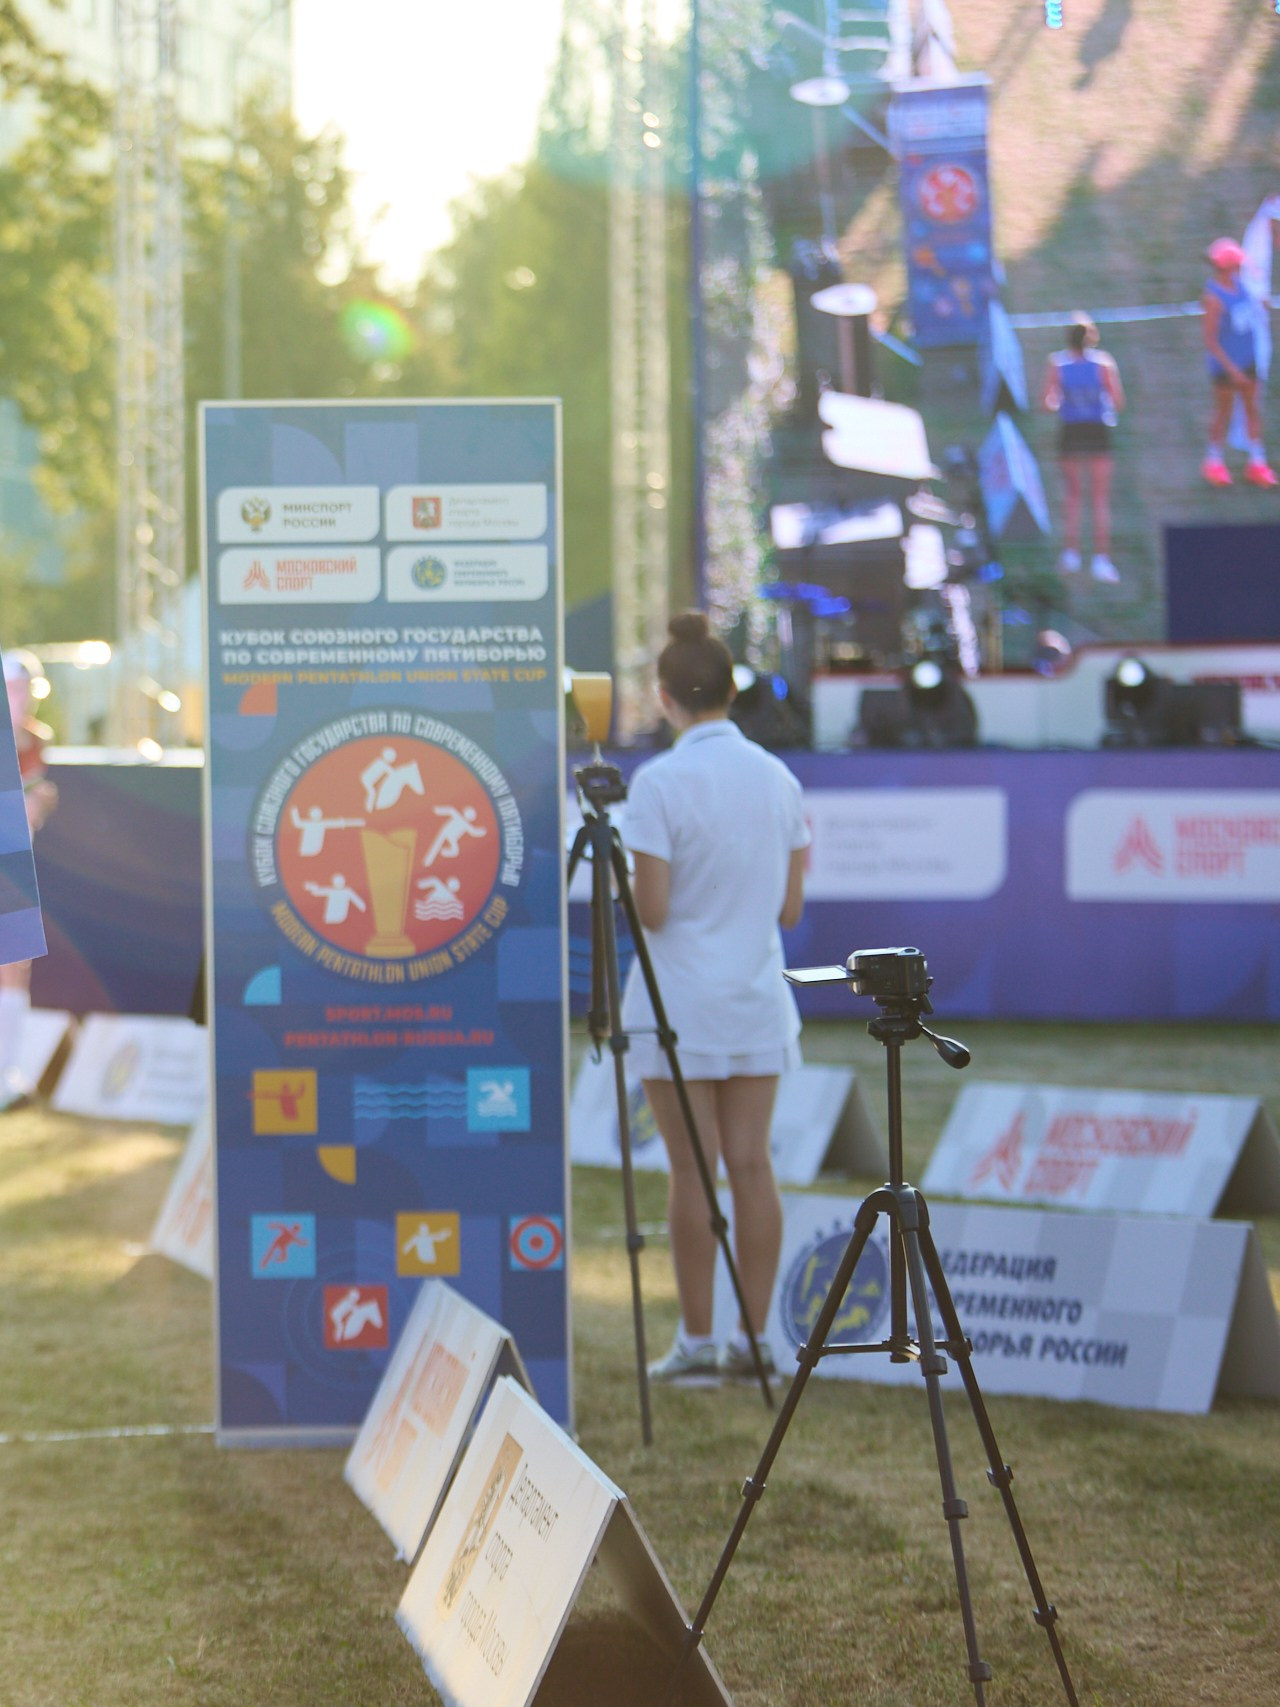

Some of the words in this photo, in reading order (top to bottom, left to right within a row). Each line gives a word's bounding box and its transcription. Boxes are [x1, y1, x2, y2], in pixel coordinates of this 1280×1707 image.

[283, 503, 352, 513] МИНСПОРТ
[283, 518, 336, 528] РОССИИ
[221, 629, 285, 646] КУБОК
[290, 629, 399, 645] СОЮЗНОГО
[403, 626, 544, 645] ГОСУДАРСТВА
[223, 649, 251, 665] ПО
[256, 647, 418, 664] СОВРЕМЕННОМУ
[424, 645, 547, 662] ПЯТИБОРЬЮ
[223, 671, 293, 685] MODERN
[297, 669, 402, 684] PENTATHLON
[406, 669, 457, 683] UNION
[463, 669, 510, 682] STATE
[514, 668, 546, 682] CUP
[391, 711, 411, 733] ПО
[941, 1250, 1057, 1282] ЕДЕРАЦИЯ
[1039, 1336, 1128, 1370] РОССИИ
